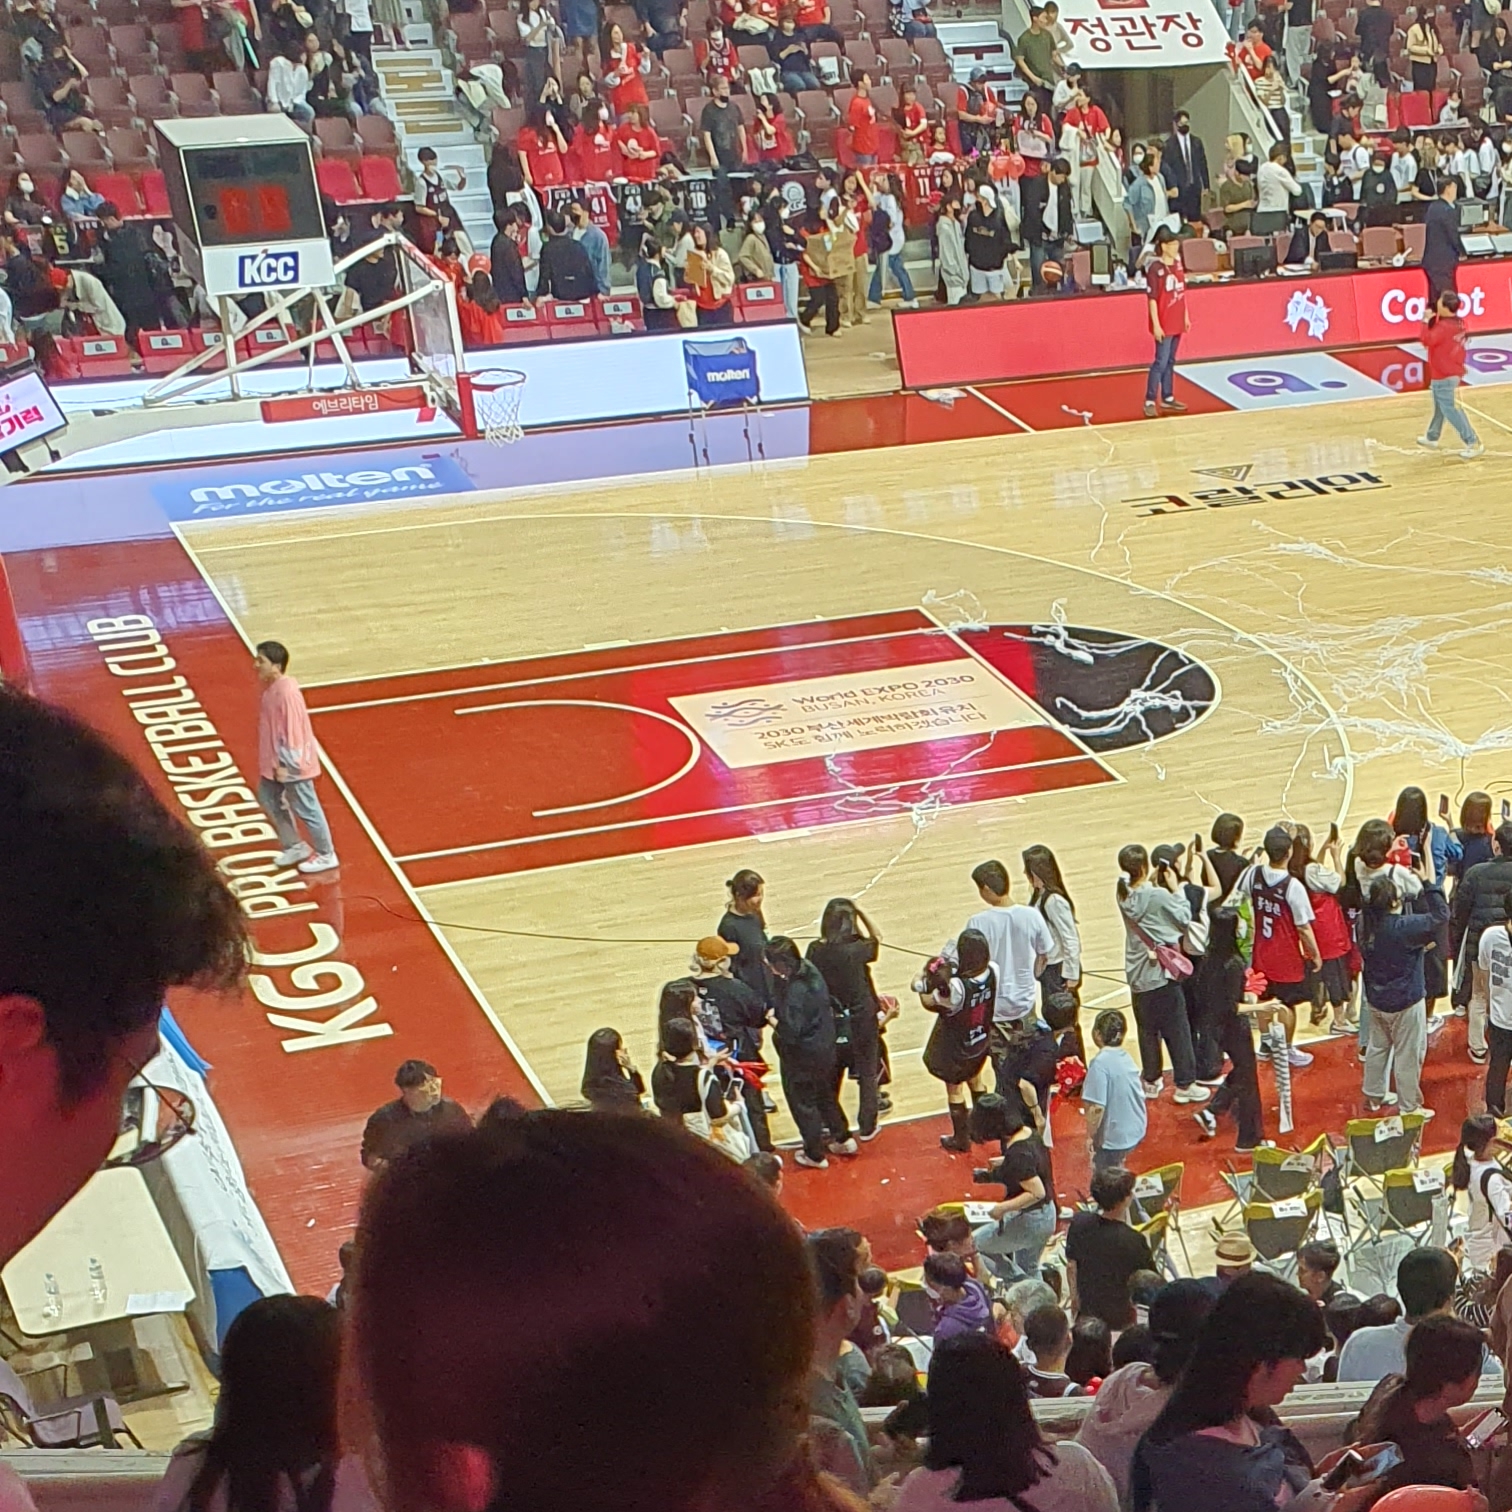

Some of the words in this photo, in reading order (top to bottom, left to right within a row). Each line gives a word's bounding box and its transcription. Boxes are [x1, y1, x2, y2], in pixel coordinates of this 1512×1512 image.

[1062, 11, 1205, 53] 정관장
[244, 249, 296, 285] KCC
[706, 367, 751, 383] molten
[0, 405, 45, 439] 기력
[312, 394, 380, 414] 에브리타임
[190, 463, 437, 504] molten
[86, 613, 178, 678] CLUB
[792, 687, 857, 705] World
[860, 681, 920, 698] EXPO
[920, 674, 976, 689] 2030
[755, 726, 805, 741] 2030
[121, 674, 280, 849] BASKETBALL
[216, 849, 320, 919] PRO
[1262, 915, 1274, 939] 5
[243, 921, 394, 1054] KGC
